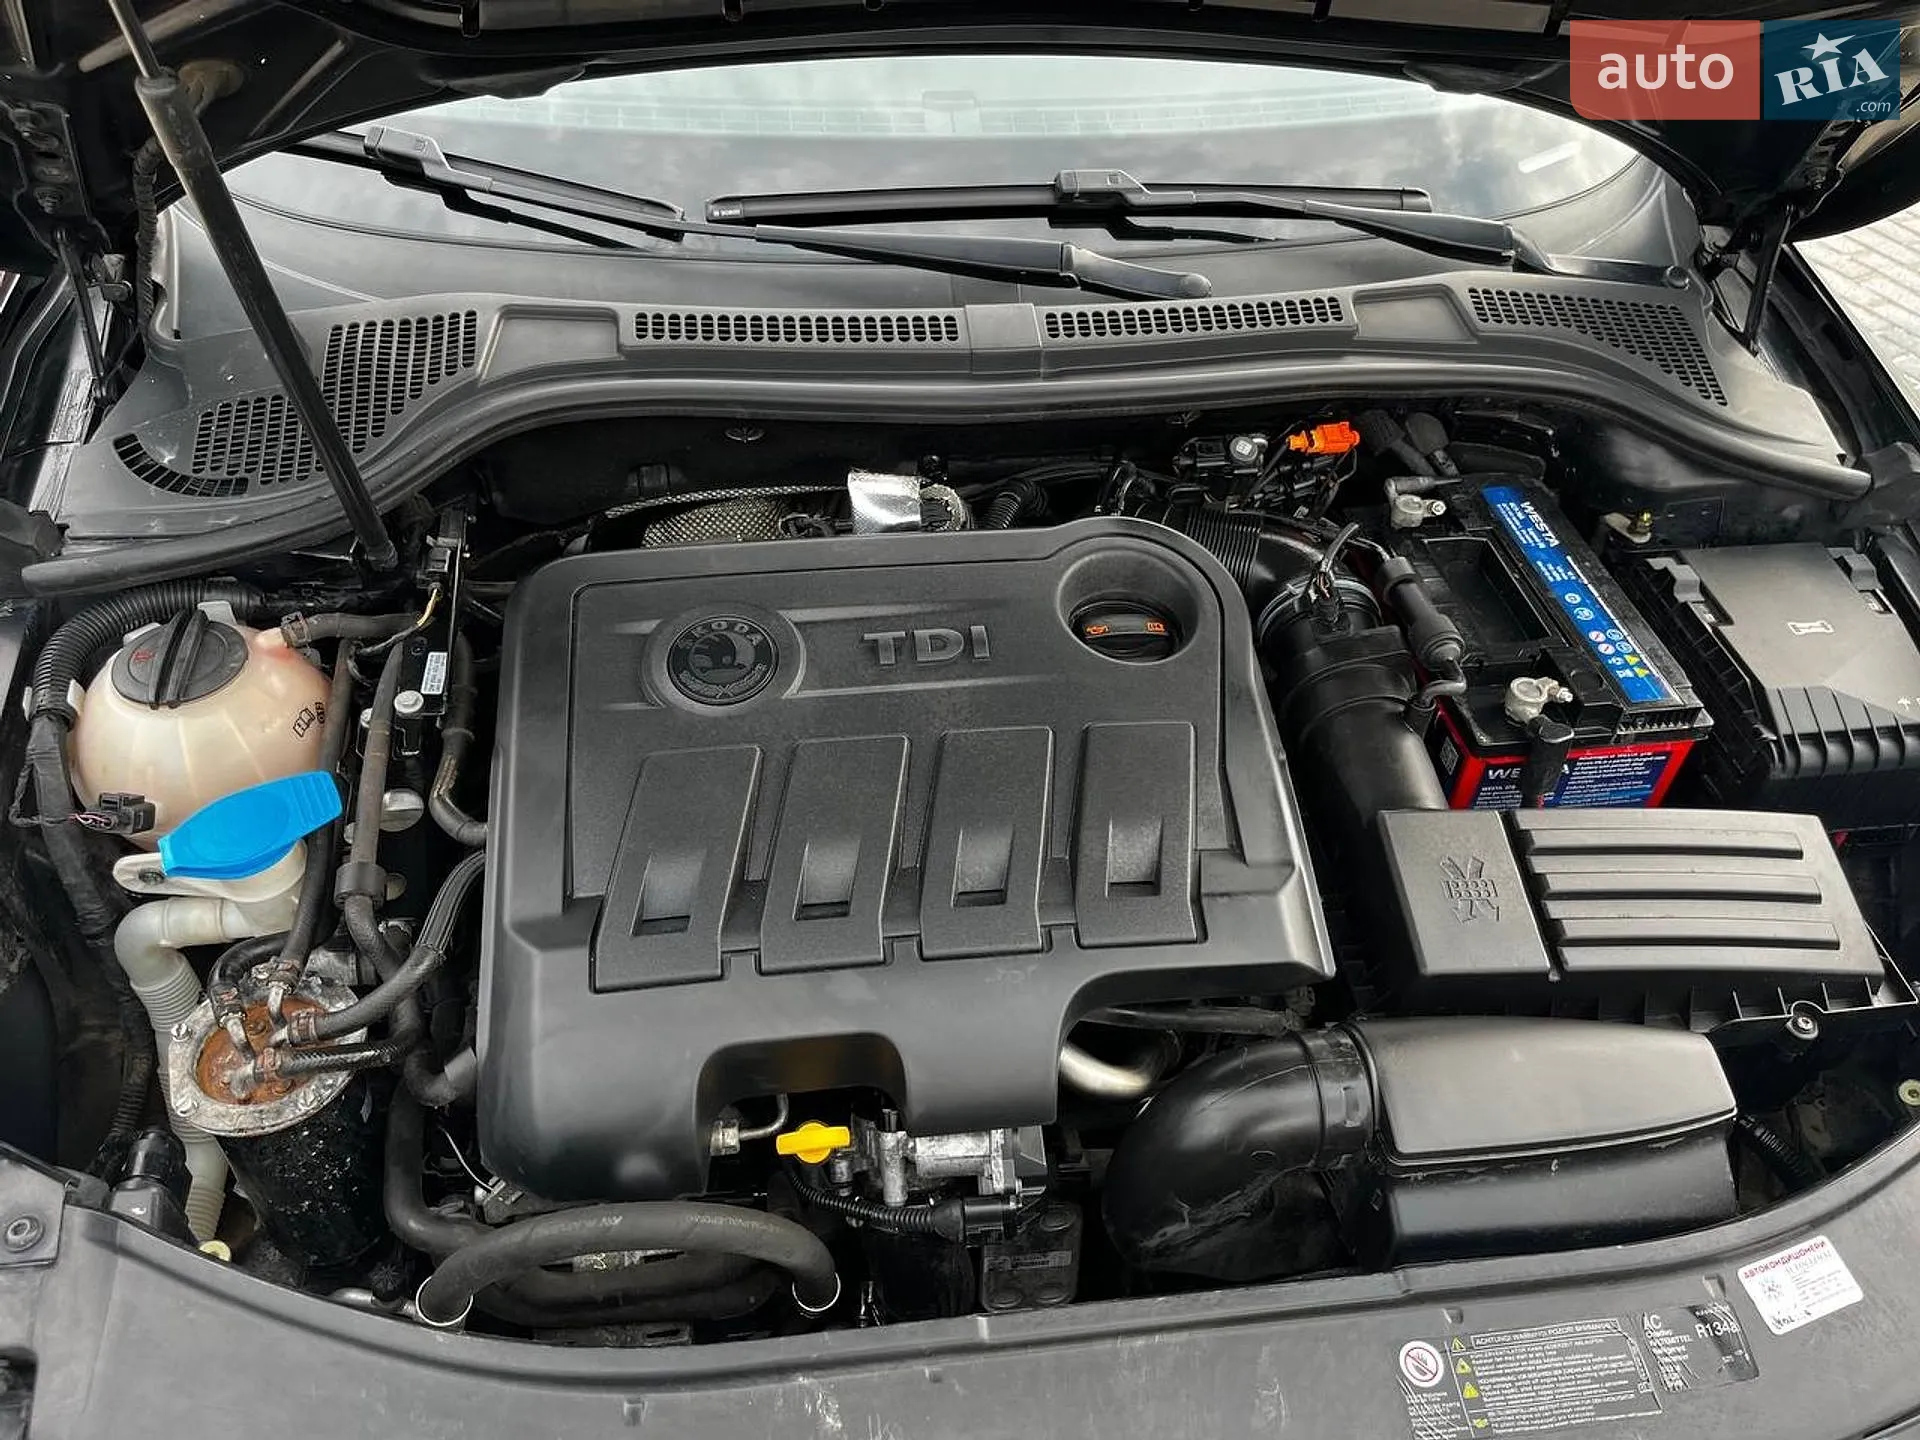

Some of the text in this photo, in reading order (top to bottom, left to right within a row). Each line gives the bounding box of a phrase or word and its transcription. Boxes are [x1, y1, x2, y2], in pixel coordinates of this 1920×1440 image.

[1520, 501, 1560, 548] WESTA
[863, 625, 990, 665] TDI
[1695, 1320, 1740, 1339] R134a
